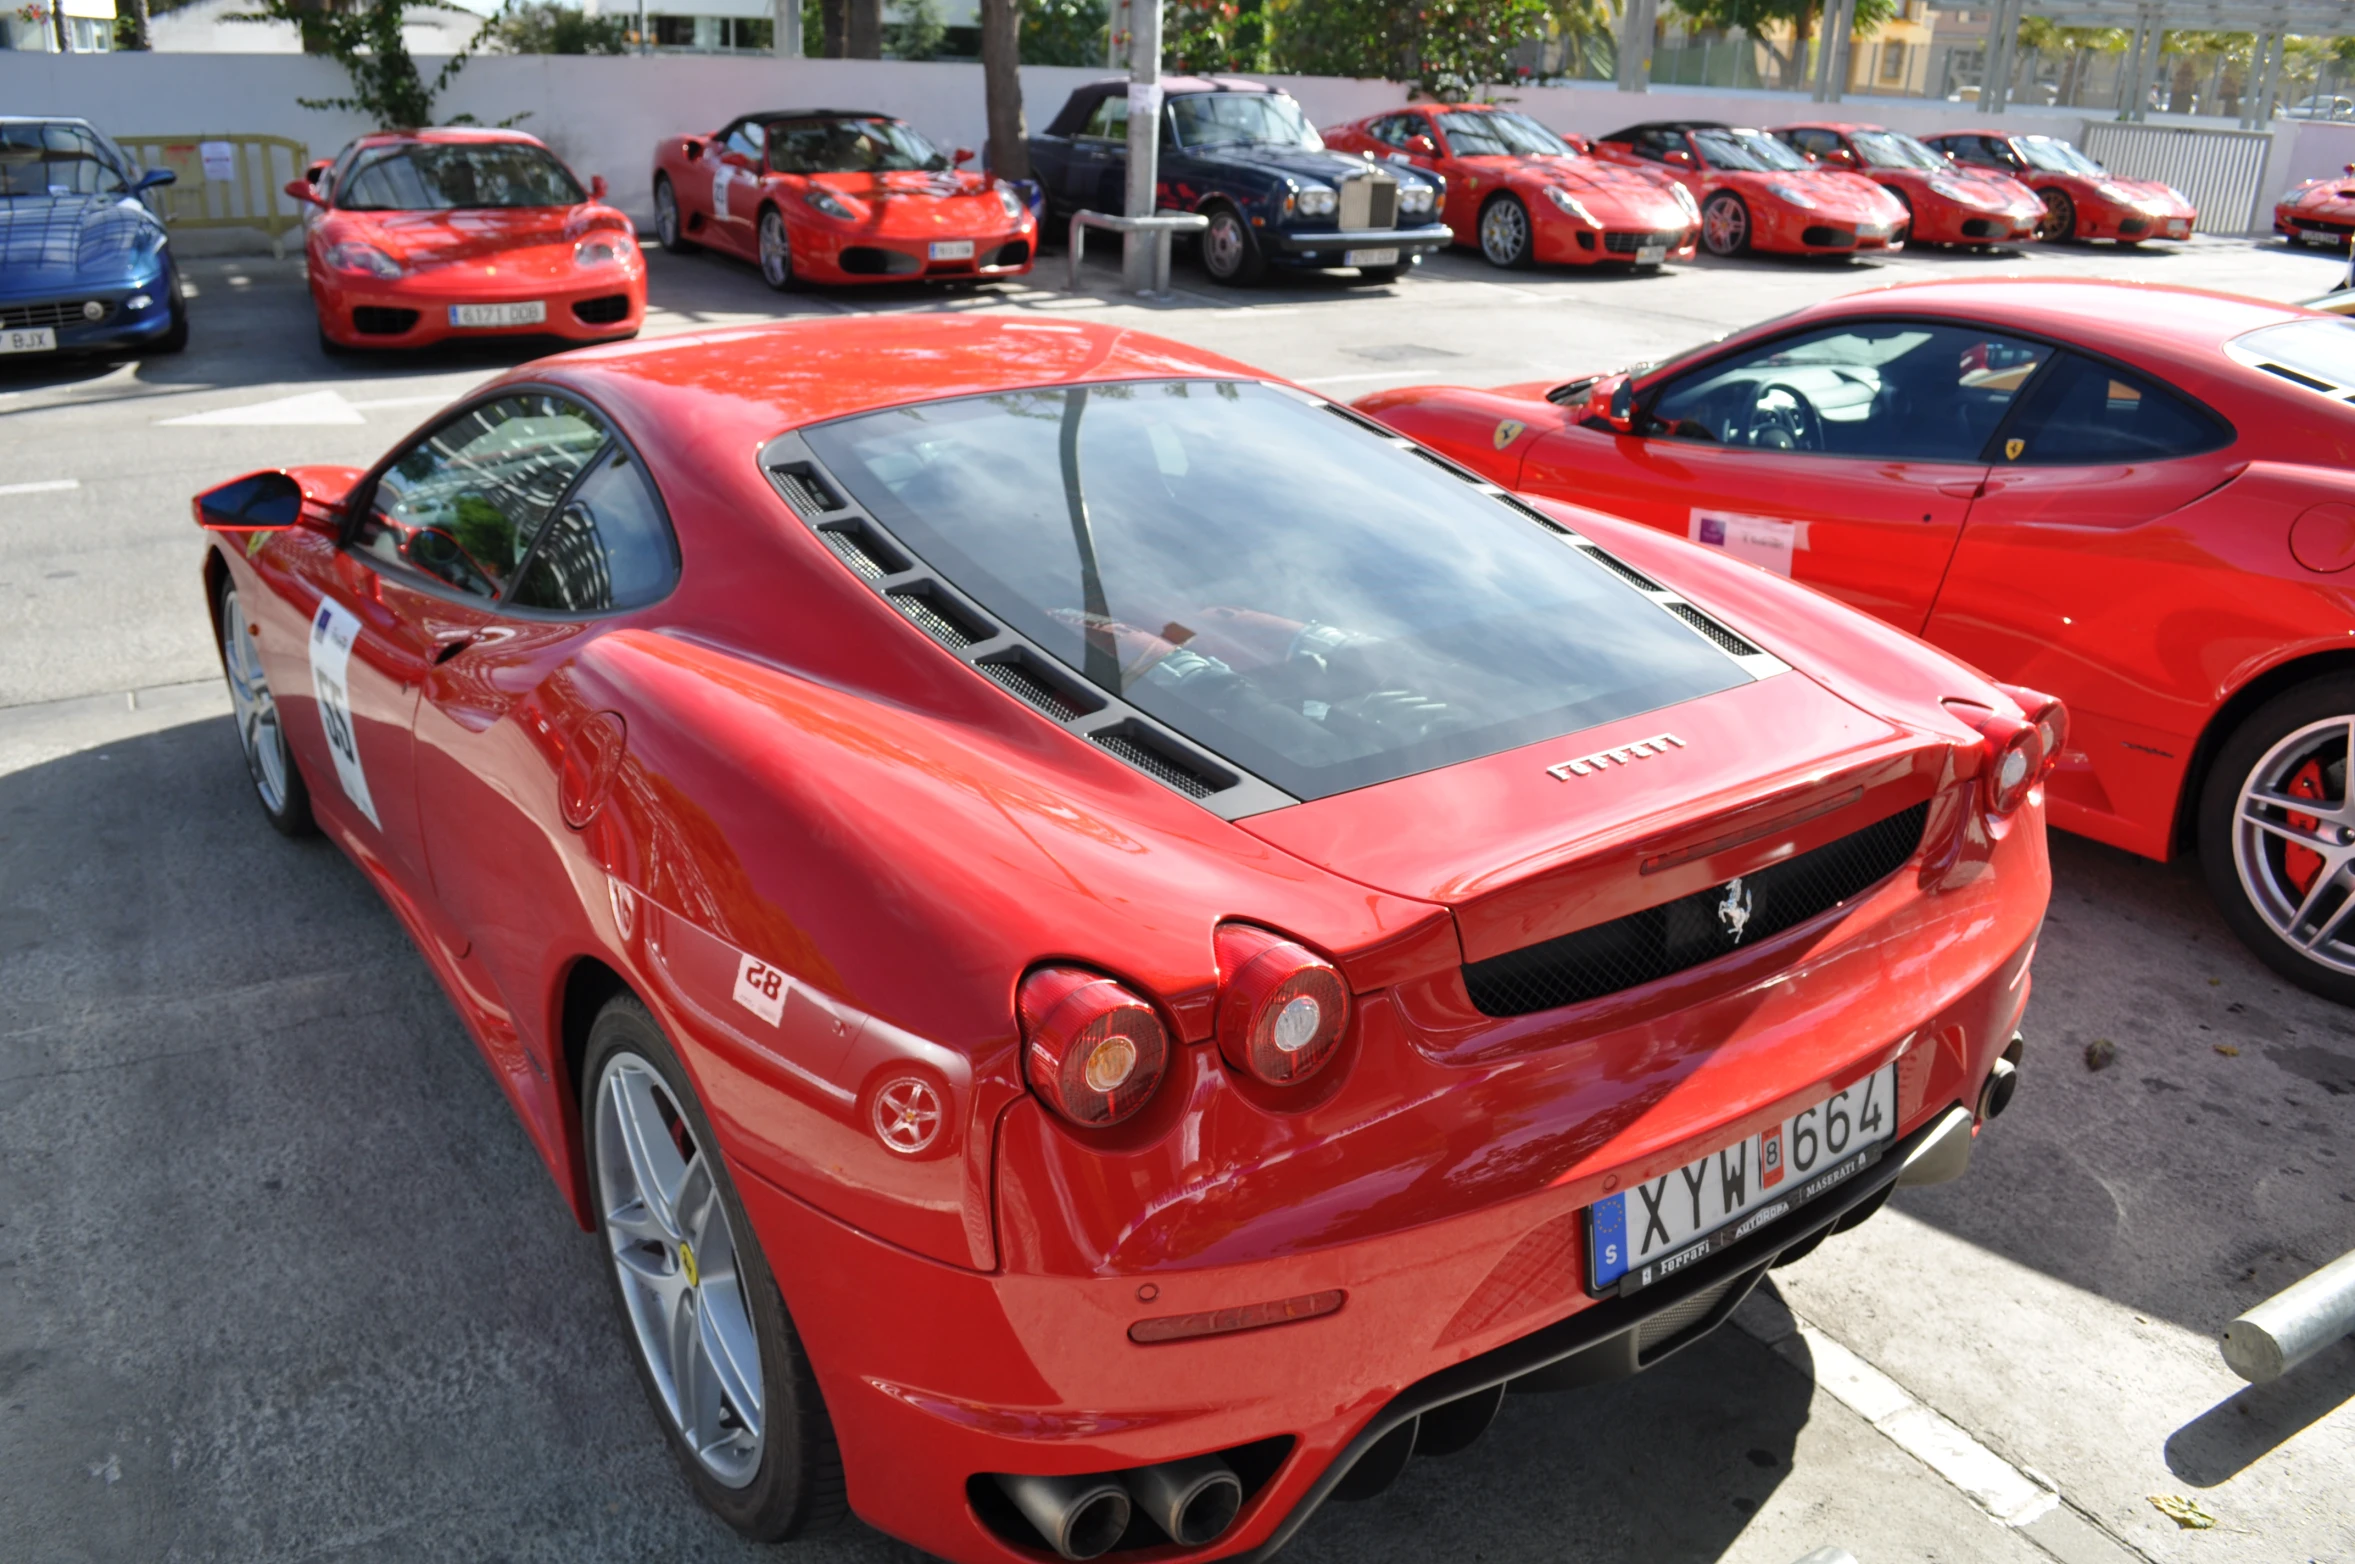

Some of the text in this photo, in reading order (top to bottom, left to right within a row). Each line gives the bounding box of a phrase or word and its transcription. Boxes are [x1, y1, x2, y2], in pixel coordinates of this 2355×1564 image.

[12, 332, 45, 349] BJX
[1546, 732, 1687, 783] Ferrari
[1637, 1073, 1883, 1256] XYW 664
[1766, 1141, 1778, 1166] 8
[1659, 1240, 1711, 1275] Ferrari
[1734, 1201, 1790, 1240] AUTOROPA
[1805, 1161, 1856, 1199] MASERATI
[1605, 1244, 1618, 1265] S
